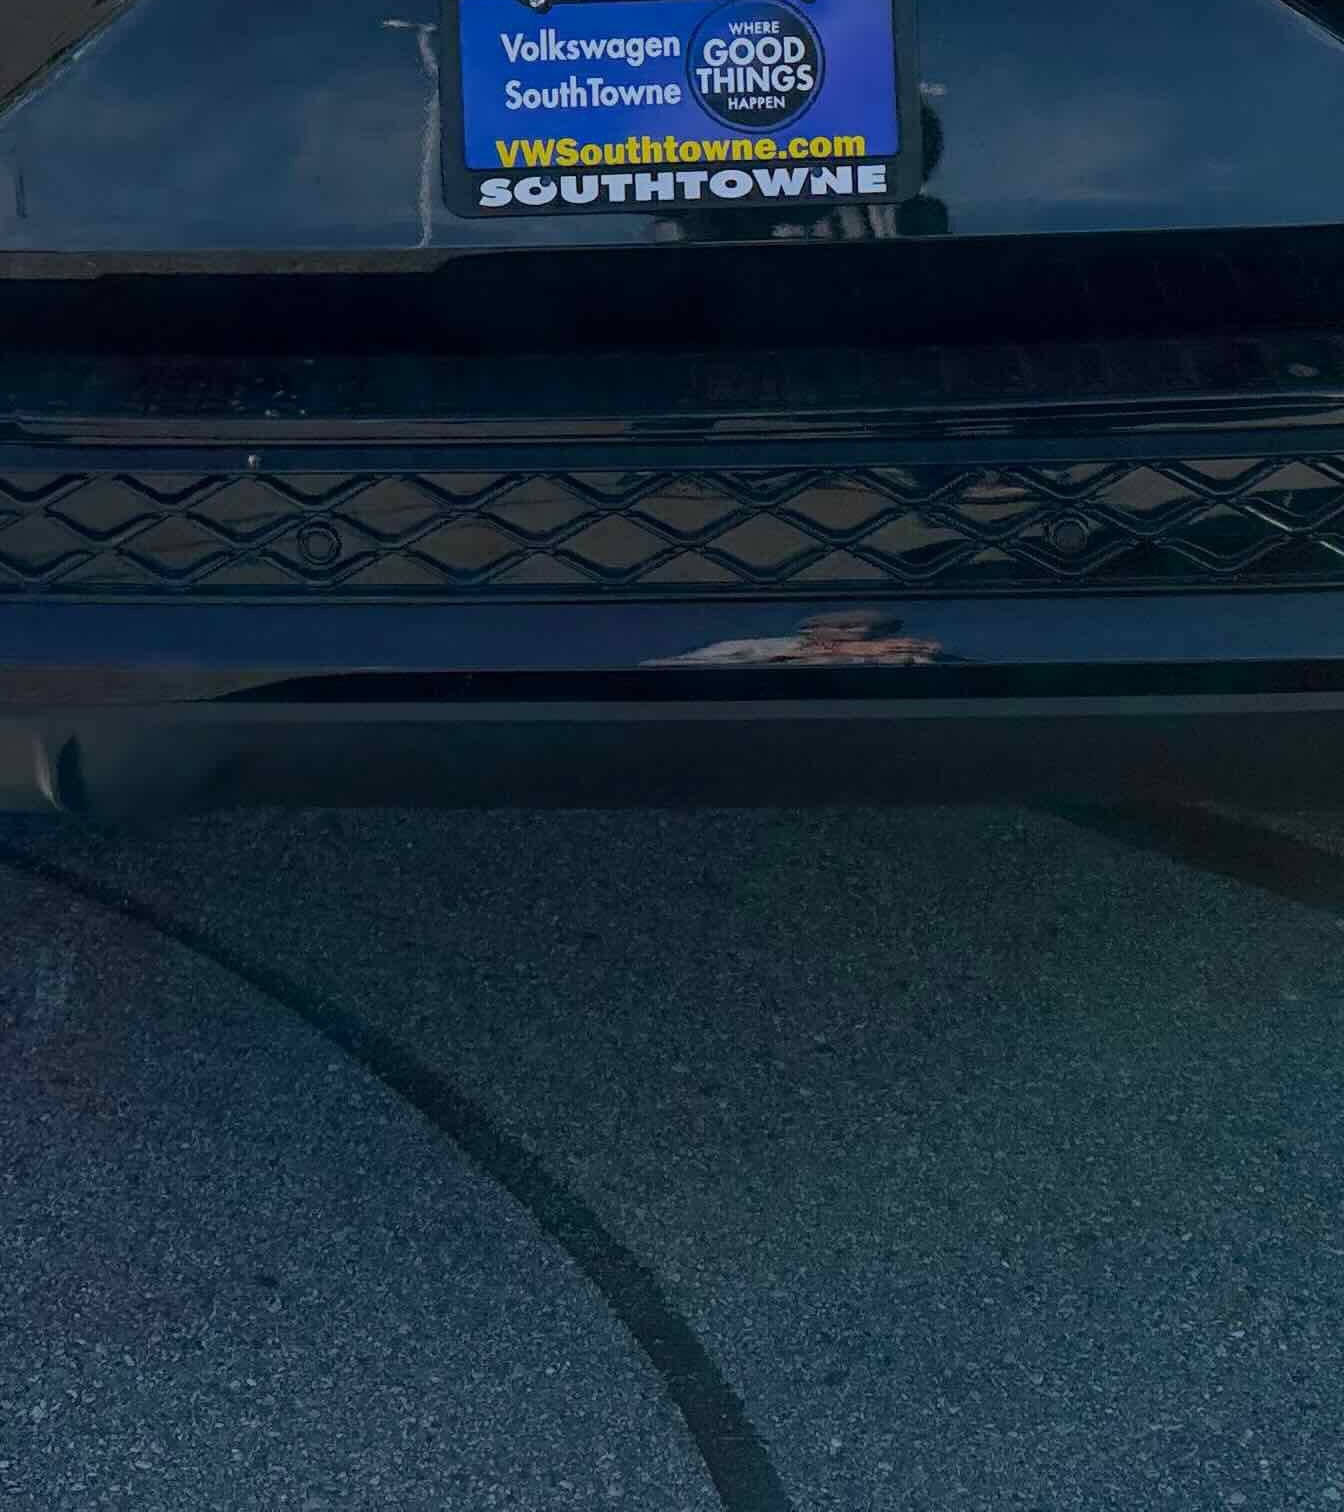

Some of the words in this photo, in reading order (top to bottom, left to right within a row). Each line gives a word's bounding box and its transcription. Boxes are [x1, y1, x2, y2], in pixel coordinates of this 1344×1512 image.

[728, 20, 781, 35] WHERE
[499, 28, 681, 67] Volkswagen
[703, 36, 806, 66] GOOD
[505, 75, 682, 110] SouthTowne
[696, 64, 815, 94] THINGS
[728, 95, 786, 111] HAPPEN
[496, 135, 866, 169] VWSouthtowne.com
[479, 164, 888, 208] SOUTHTOWNE
